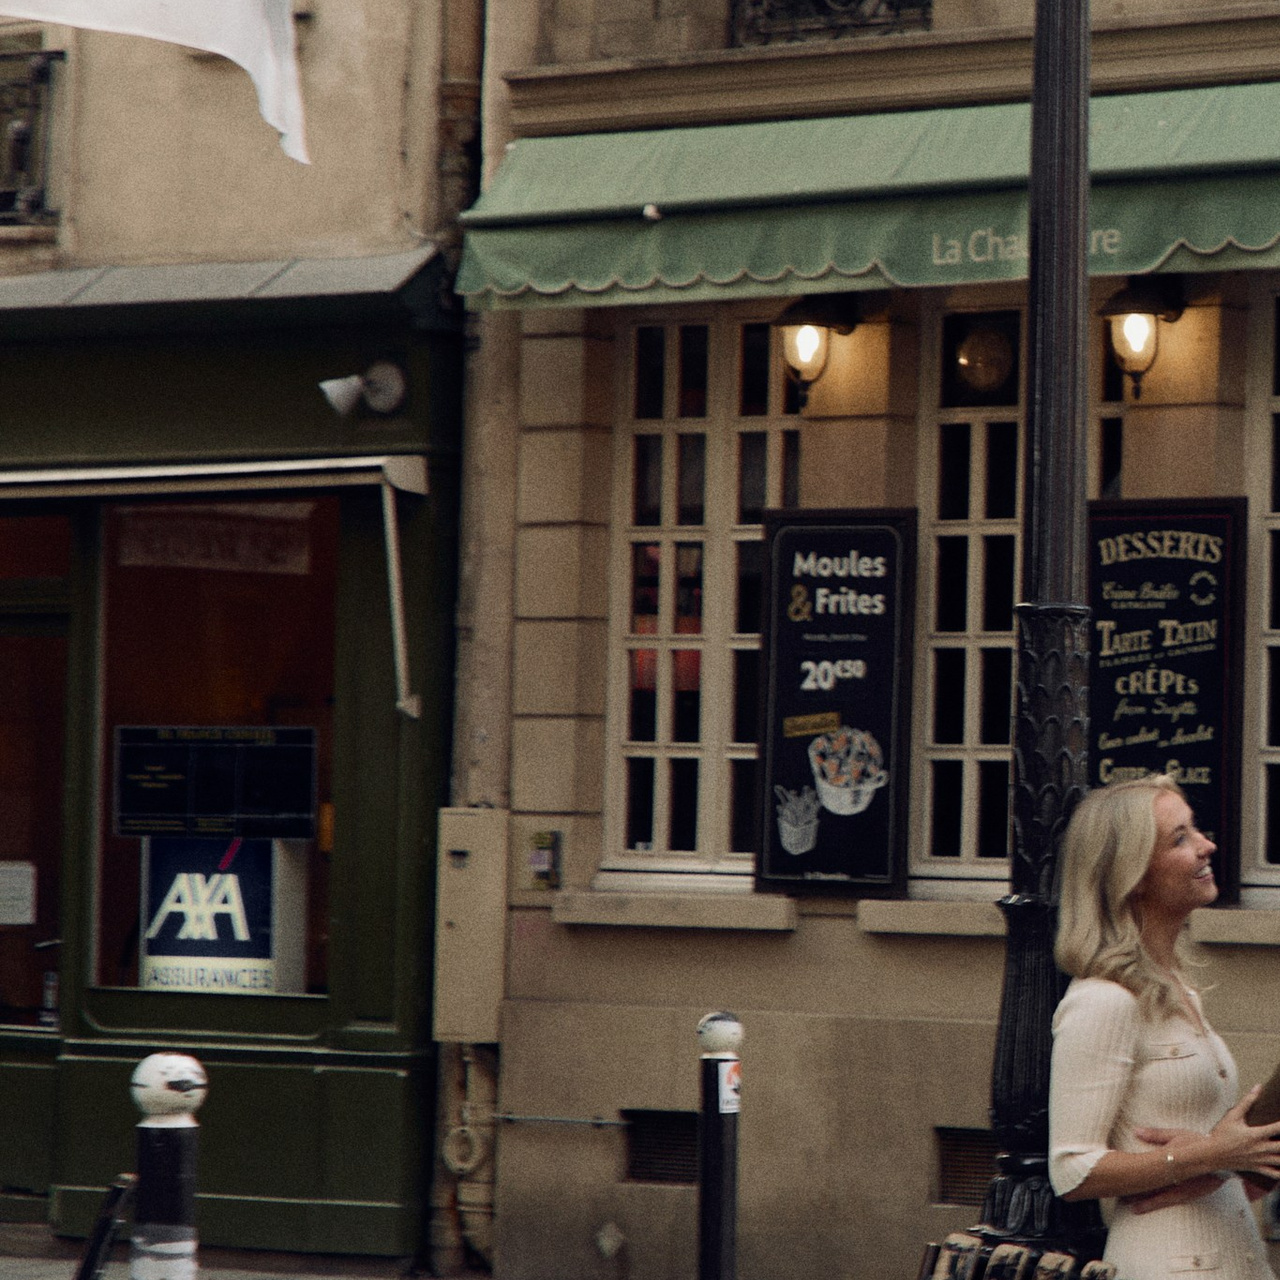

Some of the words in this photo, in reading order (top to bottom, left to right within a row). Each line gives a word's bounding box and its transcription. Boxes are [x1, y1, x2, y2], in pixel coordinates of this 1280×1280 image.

[932, 233, 962, 266] La
[793, 550, 887, 577] Moules
[1097, 531, 1224, 566] DESSERTS
[787, 584, 813, 621] &
[815, 587, 886, 615] Frites
[145, 872, 250, 941] AXA
[148, 967, 273, 988] ASSURANCES
